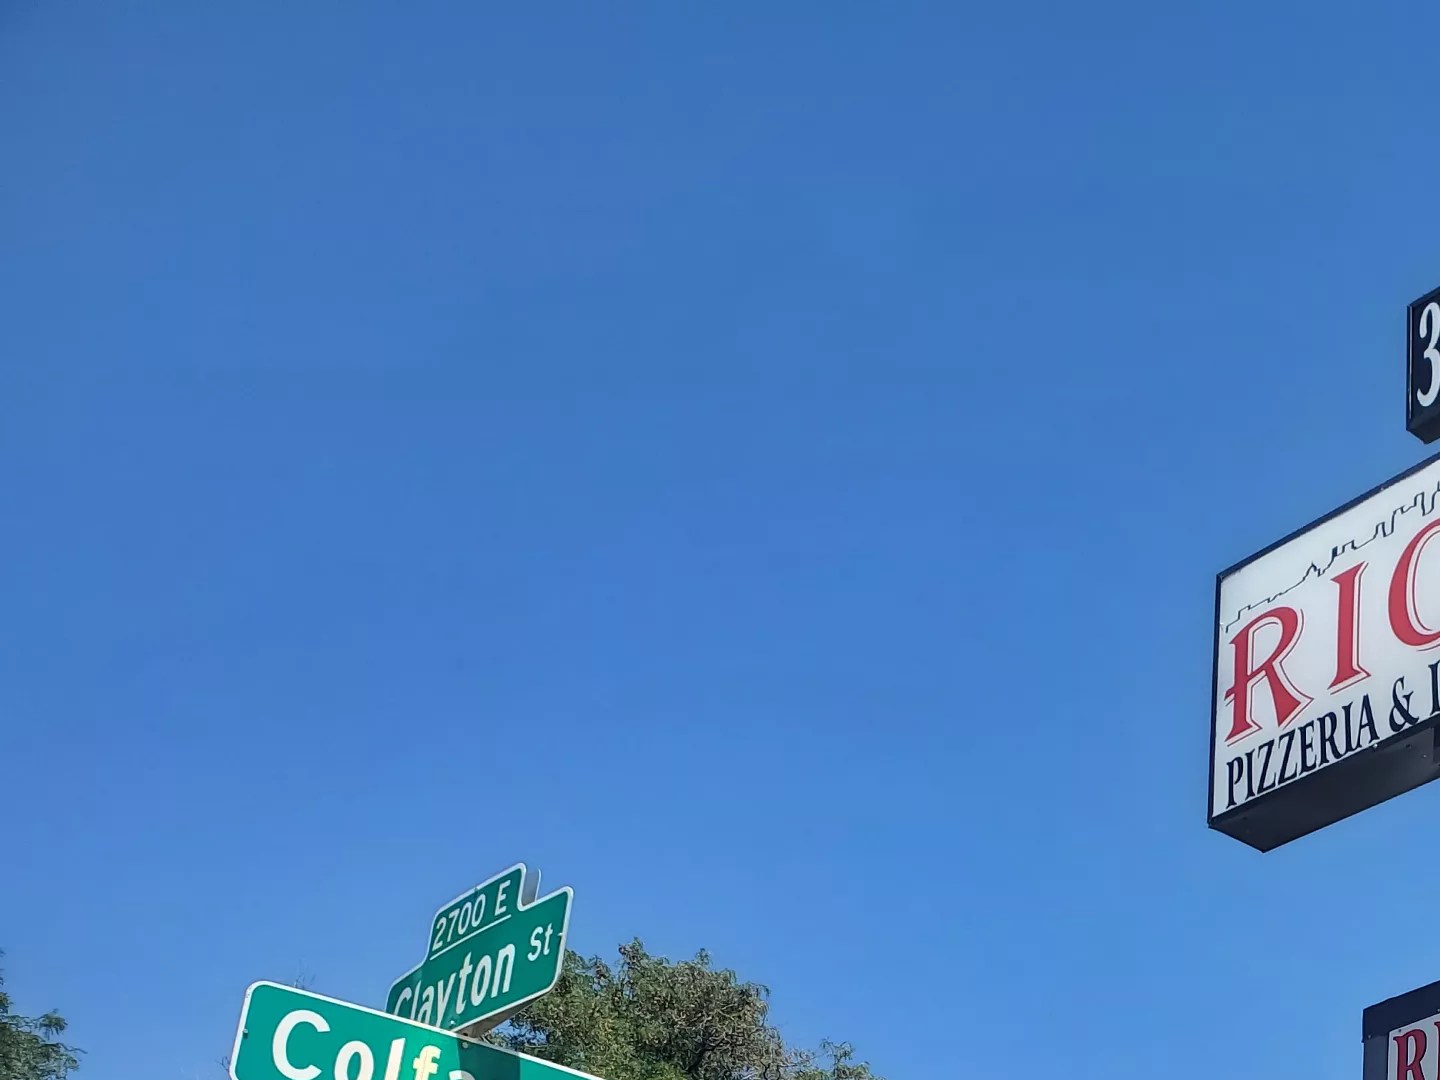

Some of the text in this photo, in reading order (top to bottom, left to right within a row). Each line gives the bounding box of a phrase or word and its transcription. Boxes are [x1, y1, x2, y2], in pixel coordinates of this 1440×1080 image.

[1226, 692, 1379, 809] PIZZERIA
[1388, 677, 1419, 733] &
[432, 879, 511, 951] 2700 E
[527, 922, 553, 961] St
